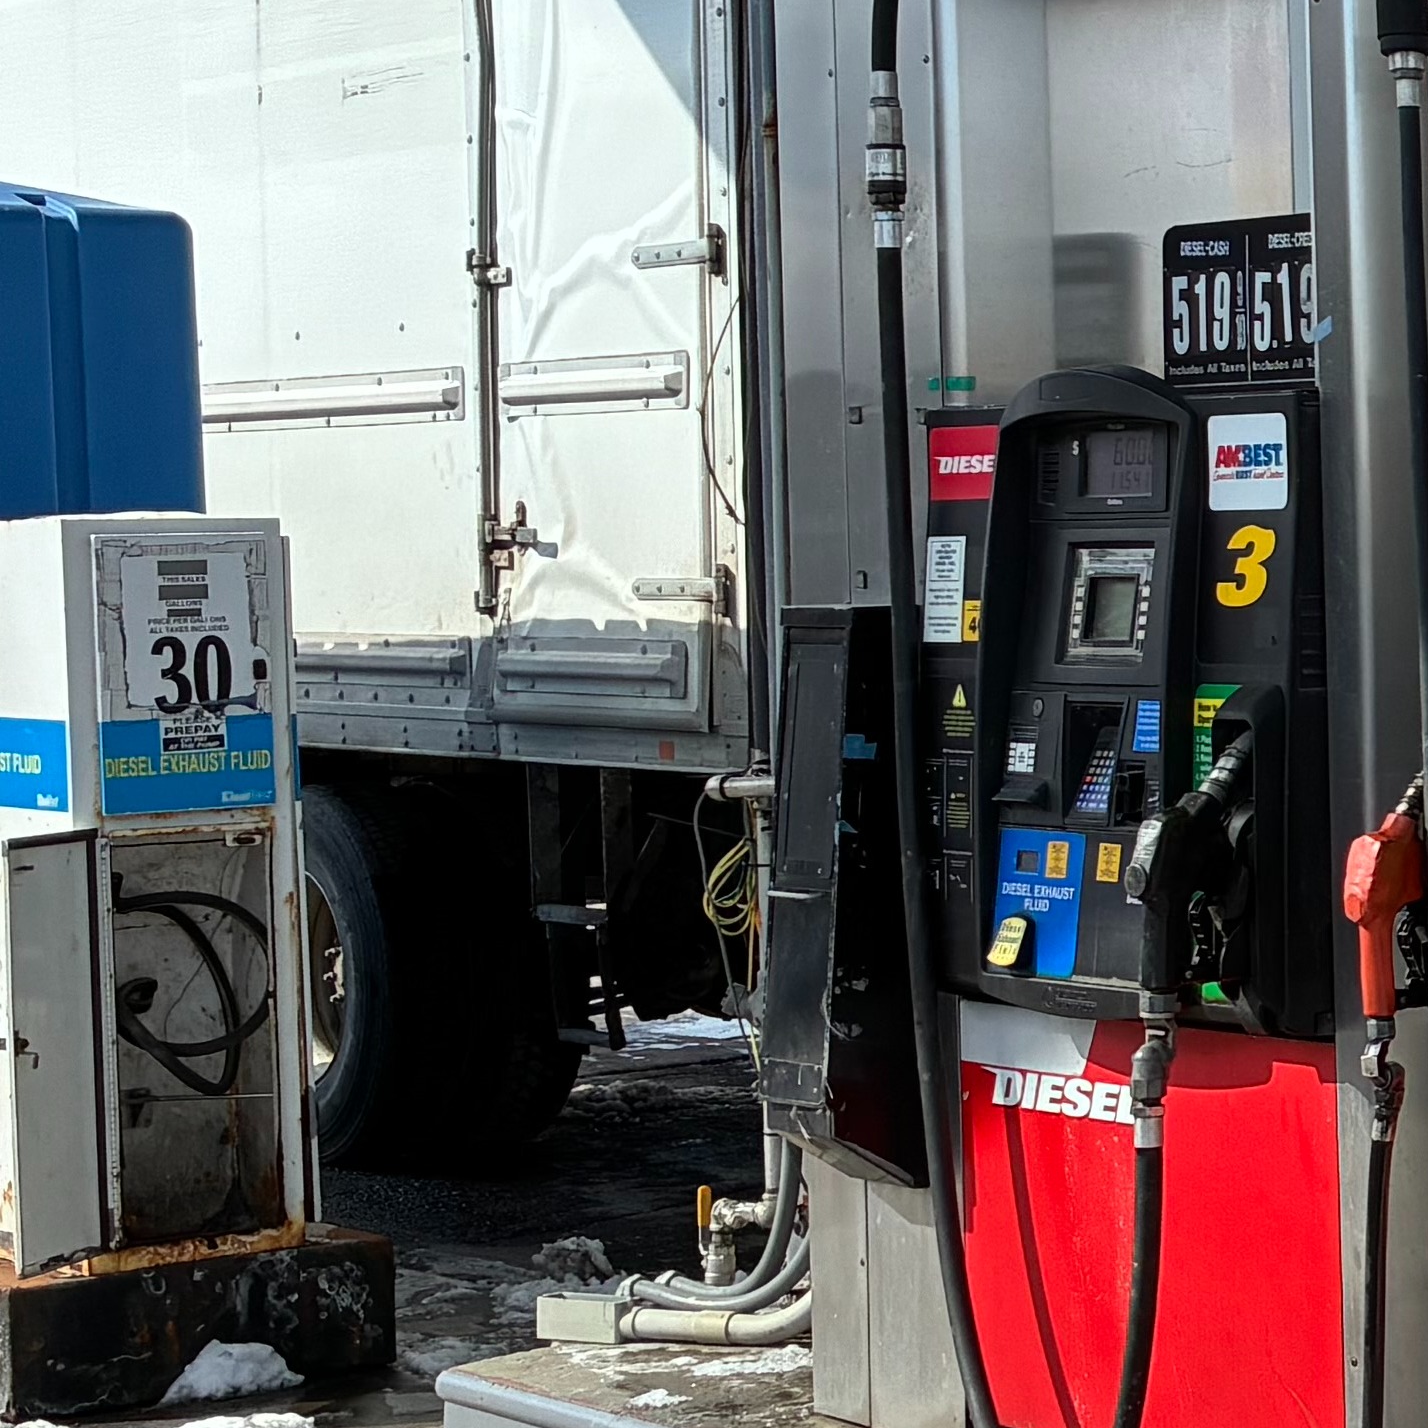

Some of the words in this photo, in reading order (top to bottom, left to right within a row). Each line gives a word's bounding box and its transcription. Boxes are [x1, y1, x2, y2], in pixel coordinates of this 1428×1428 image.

[1169, 364, 1204, 376] Includes
[1207, 363, 1218, 373] All
[1252, 360, 1289, 371] Includes
[1292, 358, 1304, 368] All
[934, 455, 996, 474] DIESE
[1215, 444, 1283, 469] AMBEST
[1216, 525, 1276, 607] 3
[151, 635, 232, 714] 30
[164, 724, 221, 737] PREPAY
[13, 753, 41, 774] FLUID
[104, 756, 157, 778] DIESEL
[160, 752, 227, 774] EXHAUST
[230, 750, 271, 770] FLUID
[1002, 882, 1032, 896] DIESEL
[1034, 884, 1075, 900] EXHAUST
[1024, 898, 1050, 912] FLUID
[981, 1066, 1134, 1124] DIESEL
